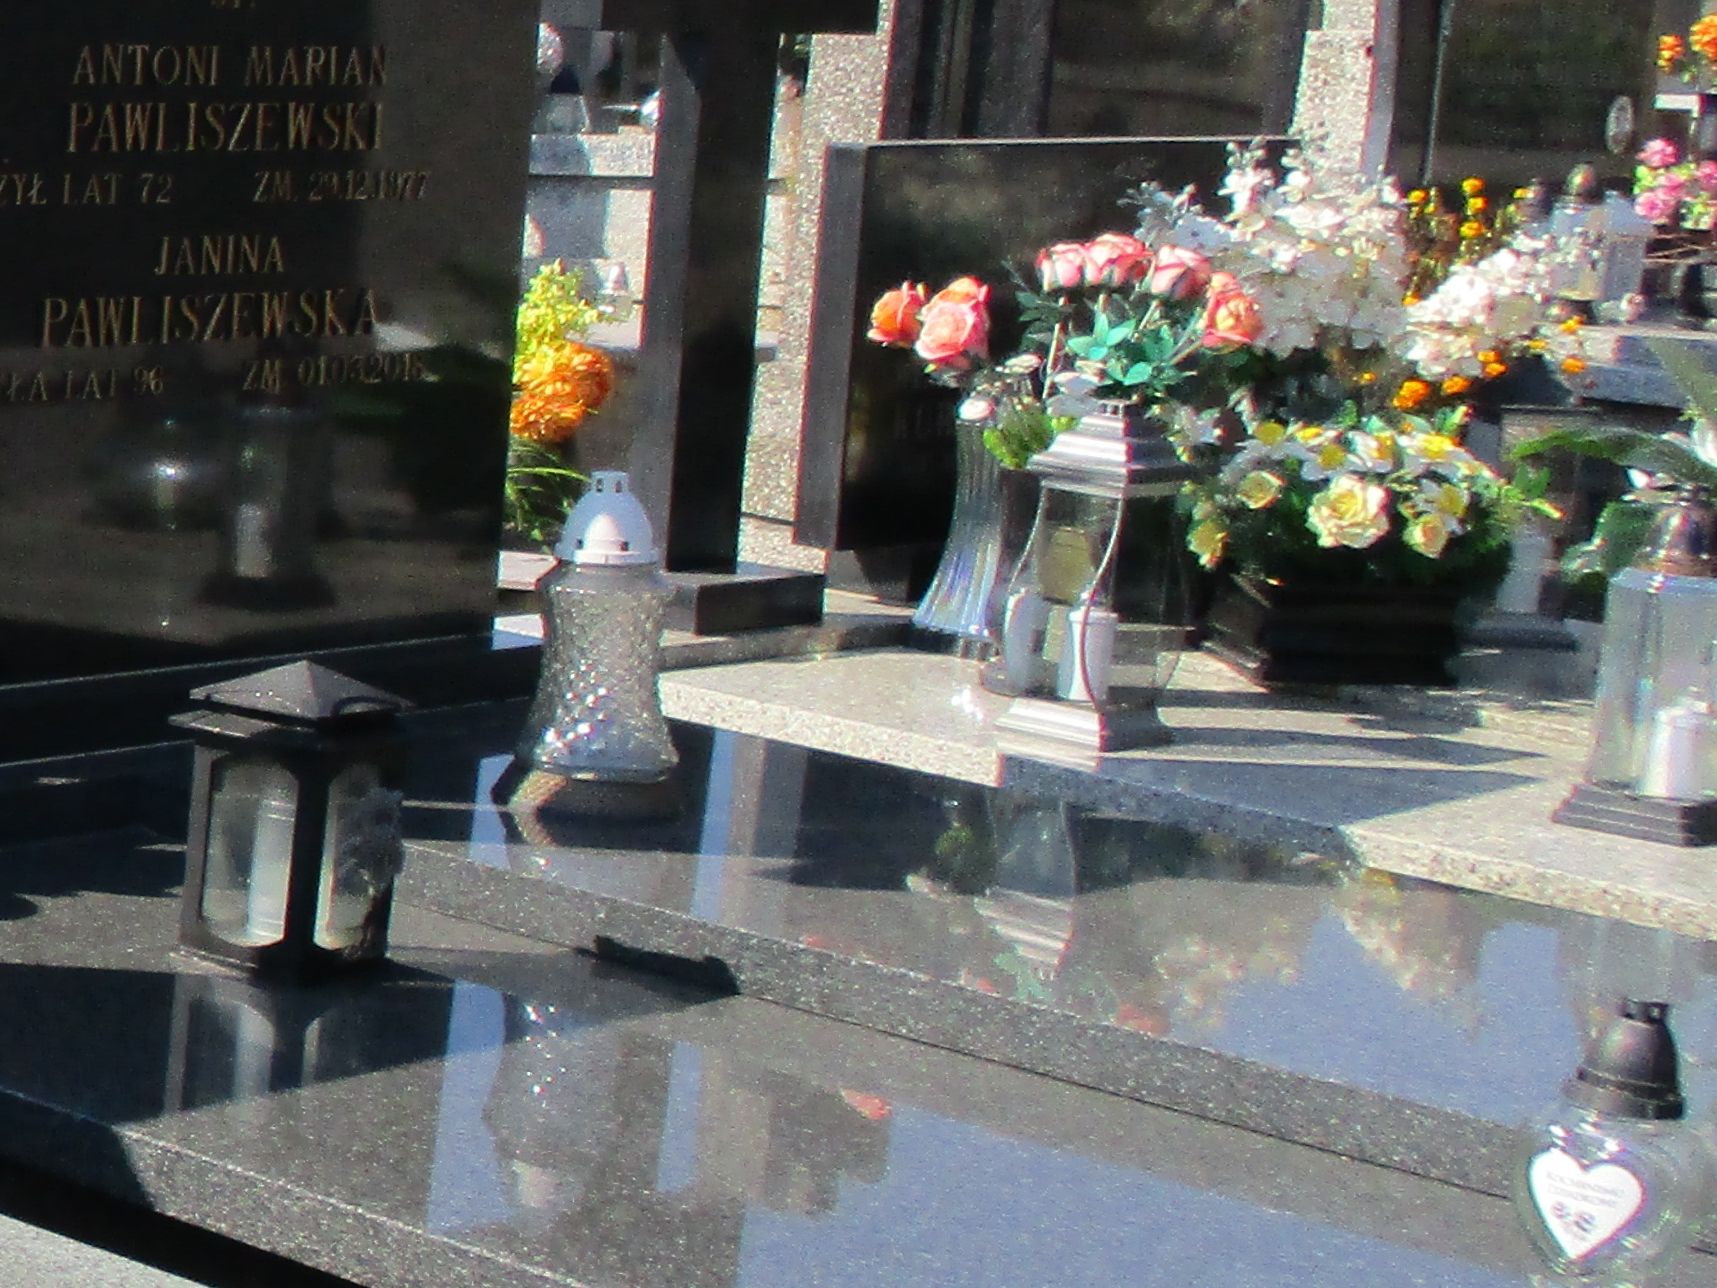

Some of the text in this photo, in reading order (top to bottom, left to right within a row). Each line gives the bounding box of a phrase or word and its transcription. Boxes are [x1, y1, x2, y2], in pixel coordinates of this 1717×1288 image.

[72, 44, 388, 87] ANTONI MARIAN
[66, 101, 384, 153] PAWLISZEWSKI
[63, 173, 122, 205] LAT
[139, 172, 172, 203] 72
[153, 234, 285, 276] JANINA
[40, 288, 378, 349] PAWLISZEWSKA
[65, 367, 119, 400] LAT
